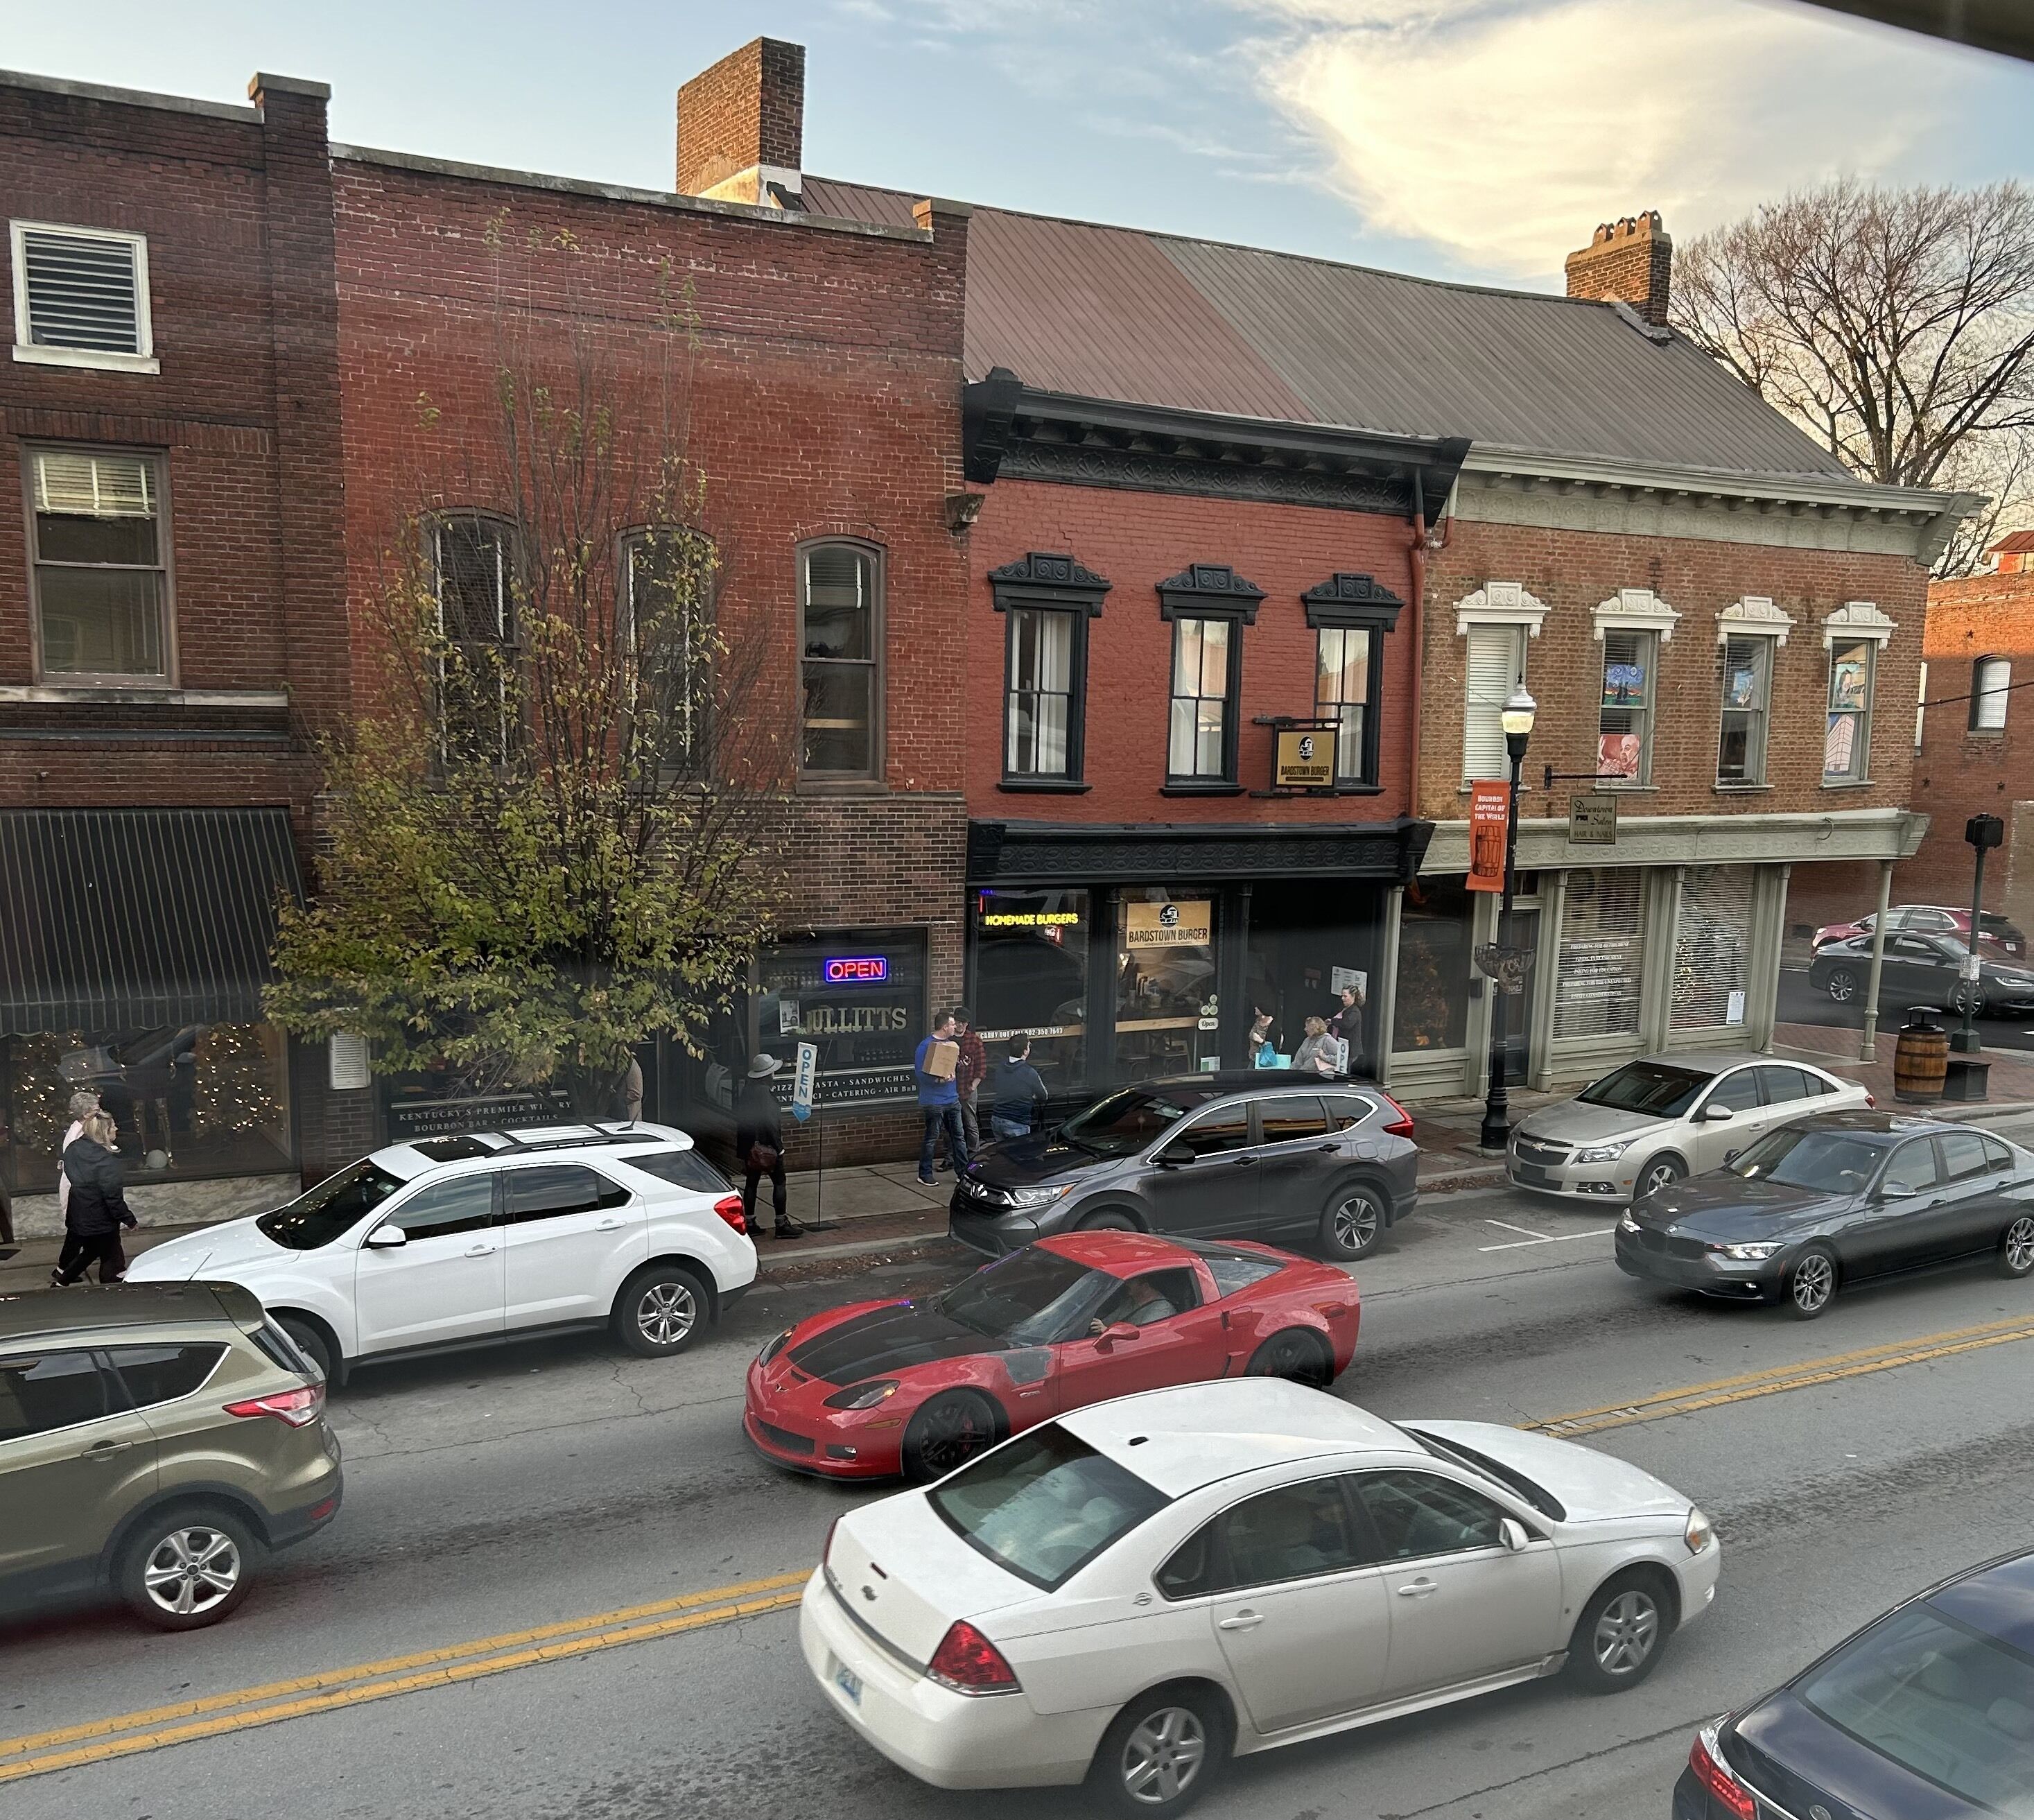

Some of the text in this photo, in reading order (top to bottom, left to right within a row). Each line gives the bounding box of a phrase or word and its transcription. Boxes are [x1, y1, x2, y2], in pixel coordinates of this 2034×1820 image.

[1574, 800, 1613, 813] Downtown
[1590, 816, 1613, 825] Salon
[985, 912, 1079, 926] HOMEMADE BURGERS
[1129, 928, 1208, 943] BARDSTOWN BURGER
[829, 961, 883, 979] OPEN
[799, 1049, 812, 1098] OPEN
[770, 1084, 793, 1092] PIZZ
[849, 1075, 910, 1086] SANDWICHES
[832, 1088, 876, 1098] CATERING
[477, 1105, 525, 1115] PREMIER
[530, 1101, 571, 1110] WIRY
[415, 1121, 464, 1132] BOURBON
[468, 1120, 488, 1128] BAR
